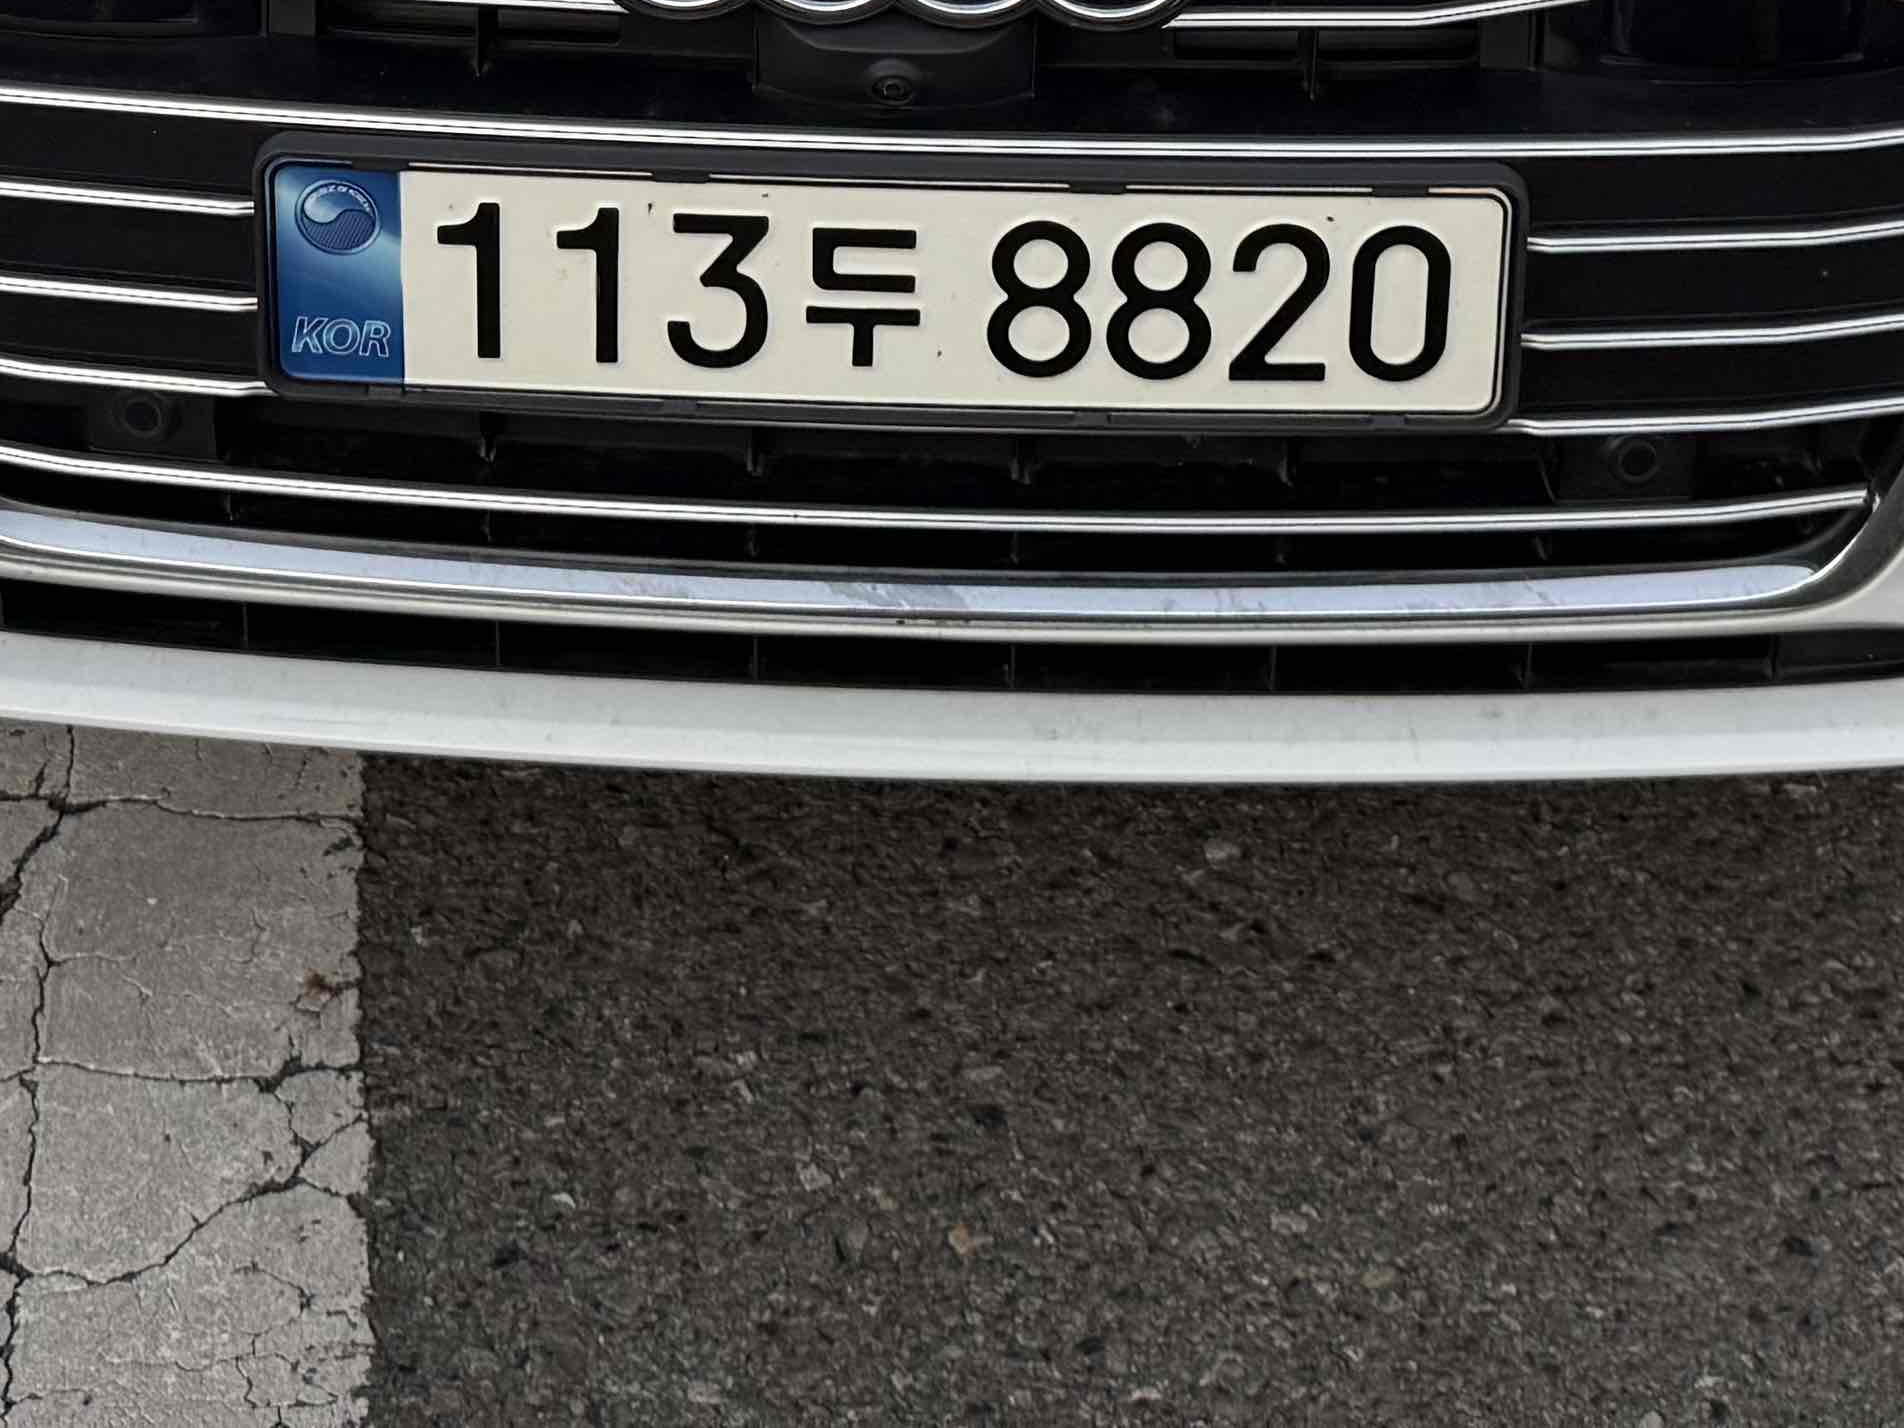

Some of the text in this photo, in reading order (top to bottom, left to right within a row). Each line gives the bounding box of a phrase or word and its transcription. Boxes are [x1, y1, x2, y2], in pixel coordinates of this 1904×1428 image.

[290, 315, 392, 358] KOR
[436, 199, 1453, 383] 113두 8820
